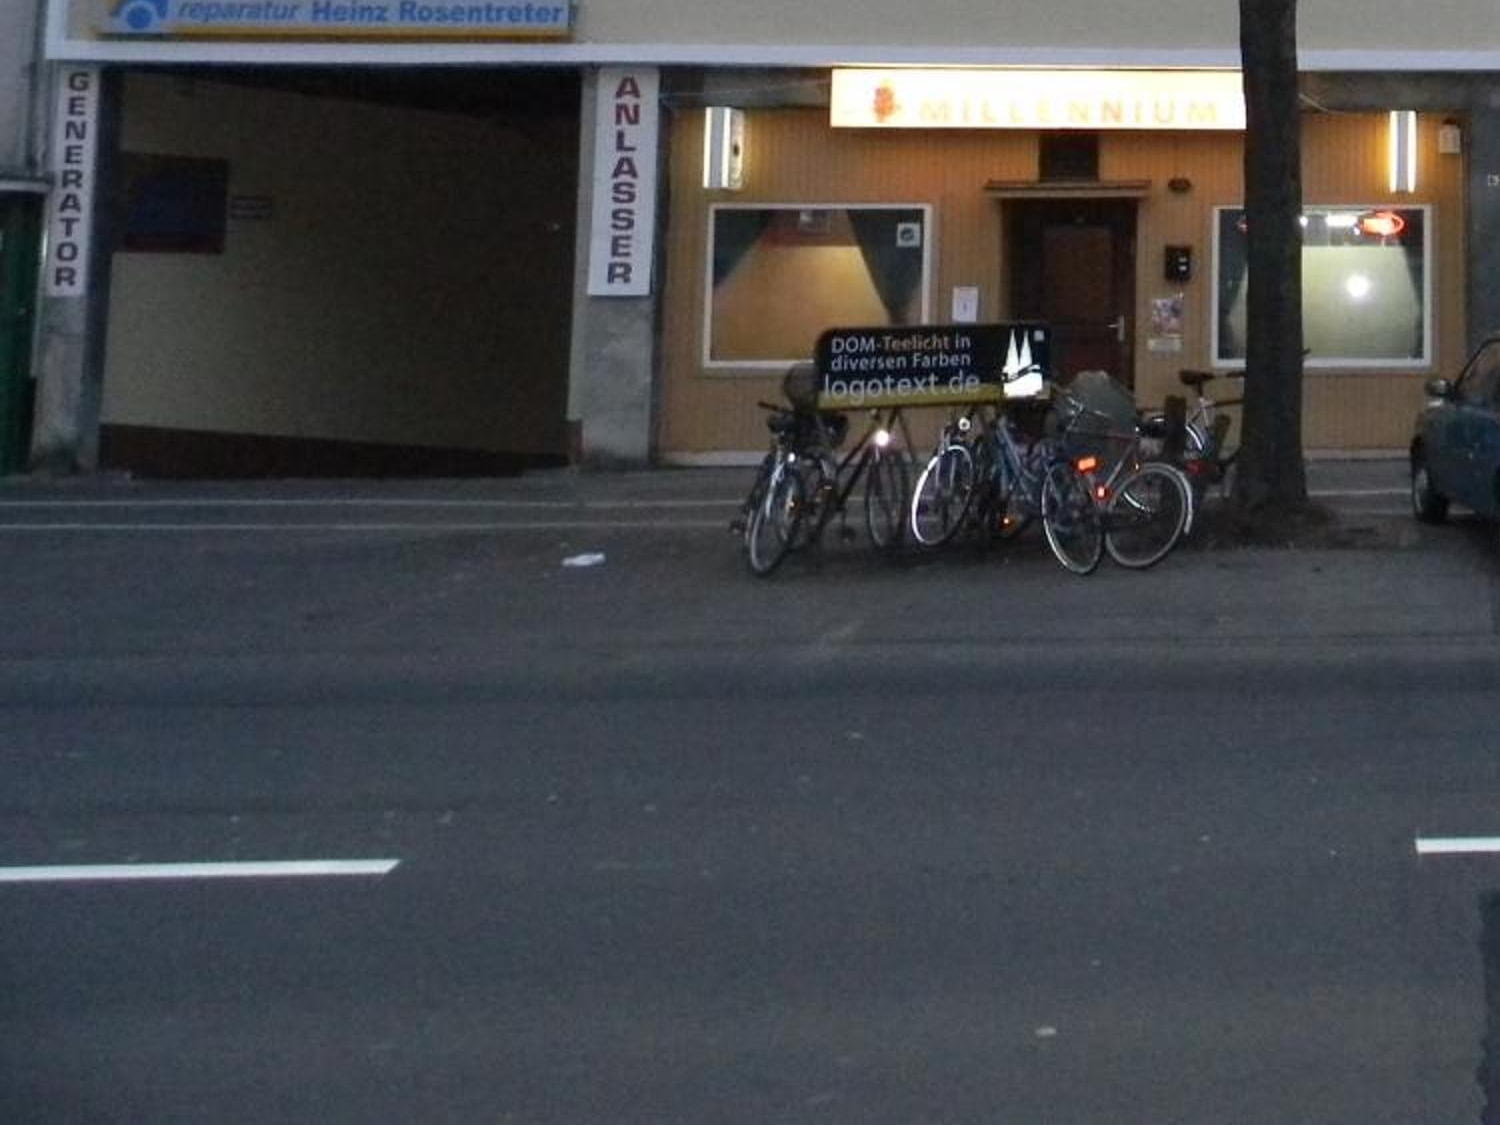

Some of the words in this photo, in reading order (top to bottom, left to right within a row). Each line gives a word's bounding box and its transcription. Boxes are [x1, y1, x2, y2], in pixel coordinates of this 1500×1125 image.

[178, 1, 299, 23] reparatur
[312, 0, 387, 22] Heinz
[400, 1, 563, 22] Rosentreter
[919, 96, 1218, 124] MILLENNIUM
[54, 72, 89, 286] GENERATOR
[607, 75, 641, 284] ANLASSER
[831, 333, 949, 354] DOM-Teelicht
[954, 333, 971, 349] in
[831, 354, 907, 372] diversen
[912, 350, 971, 368] Farben
[824, 369, 981, 404] logotext.de
